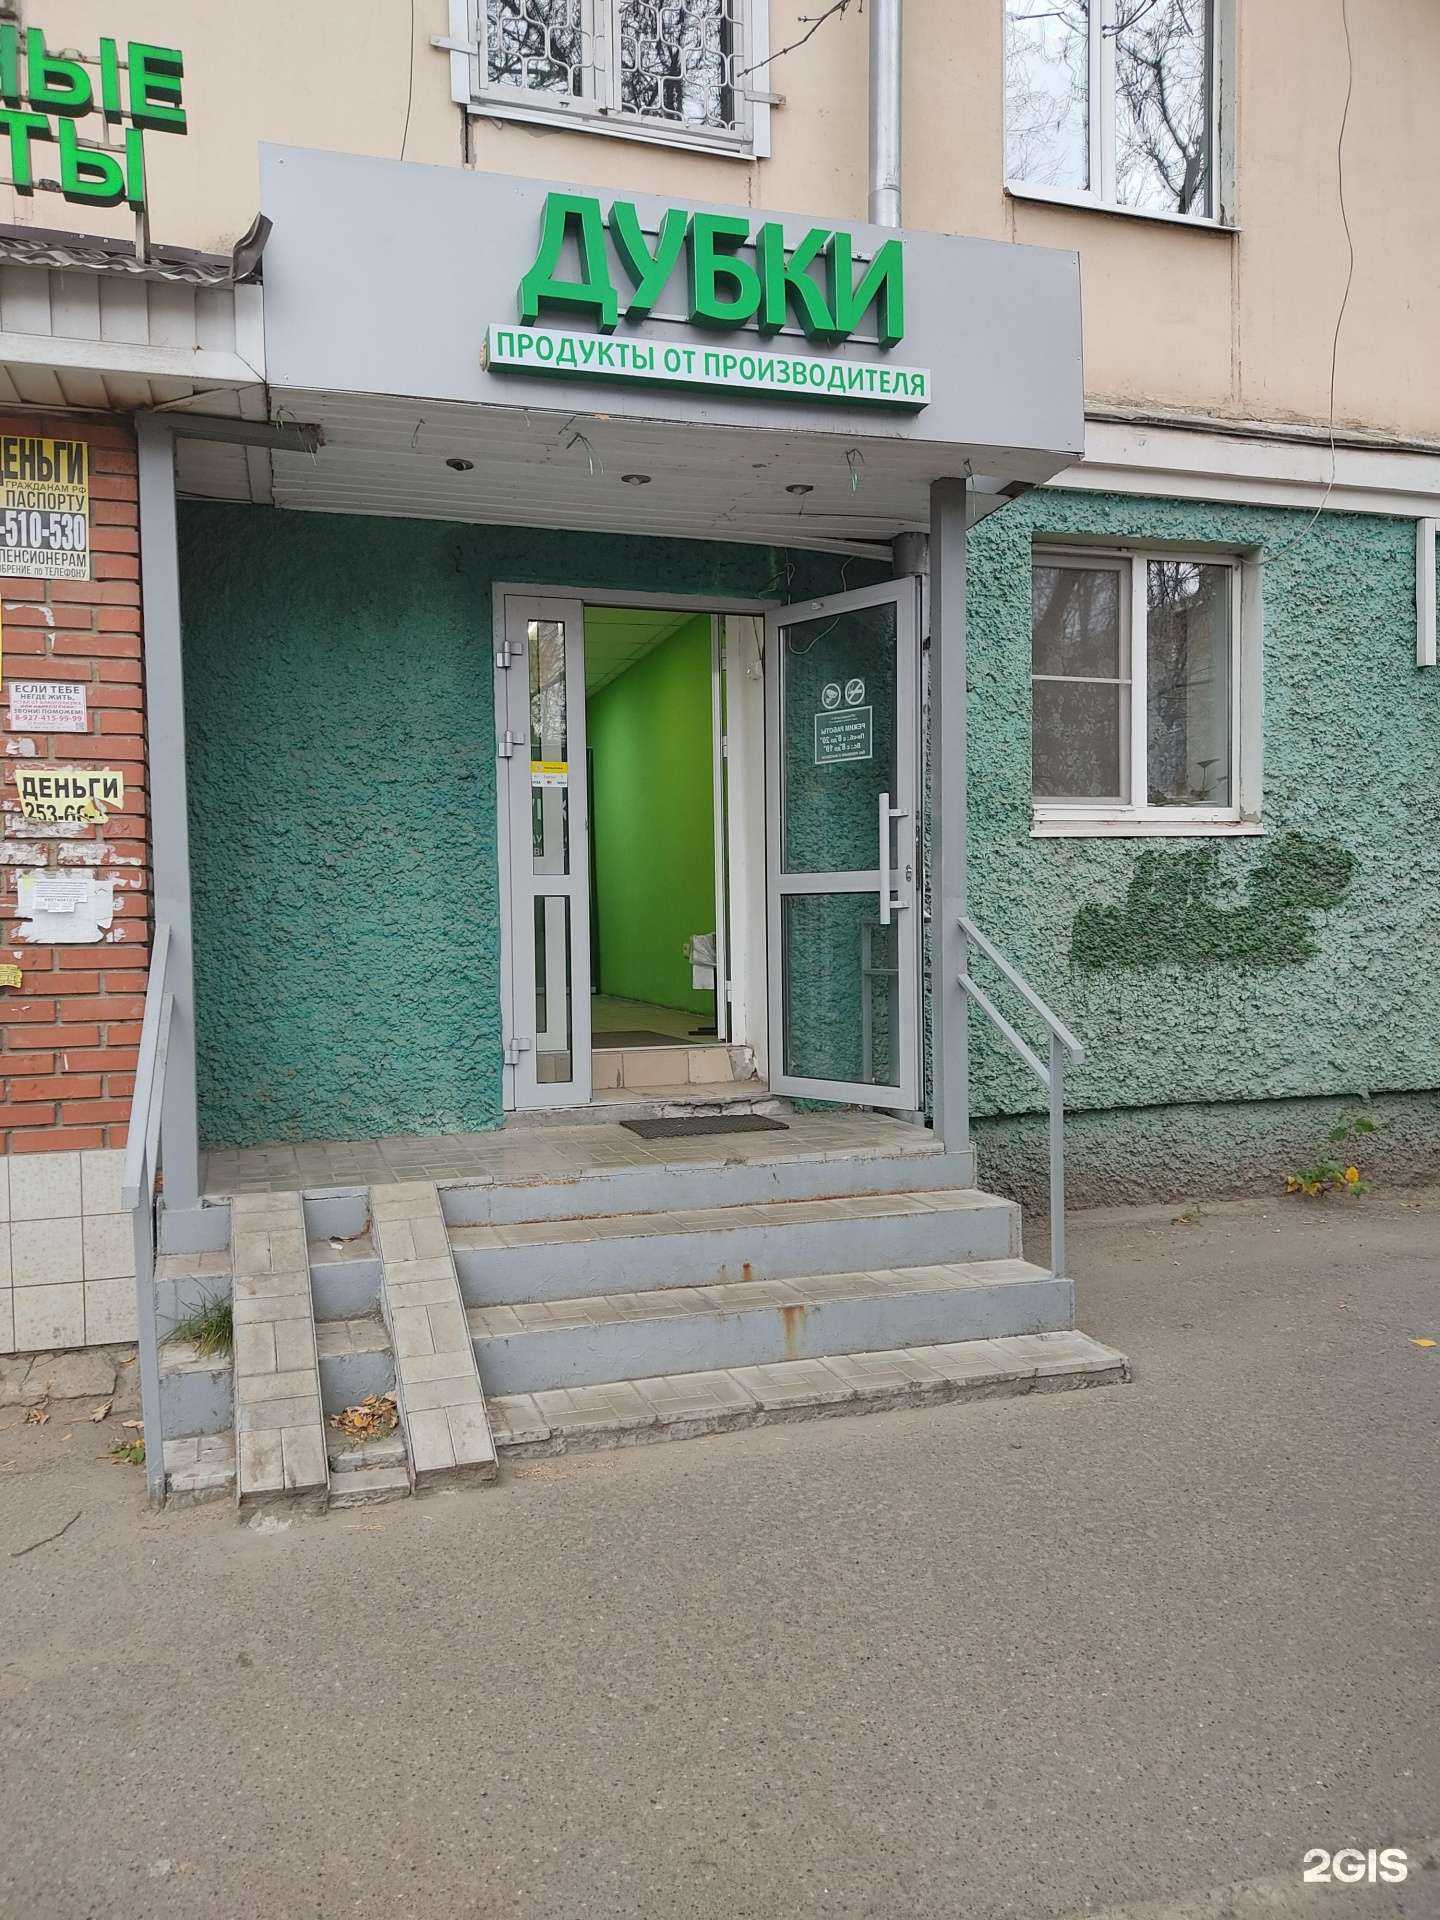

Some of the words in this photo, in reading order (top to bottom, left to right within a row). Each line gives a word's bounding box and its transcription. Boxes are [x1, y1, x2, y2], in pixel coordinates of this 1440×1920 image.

[0, 109, 144, 212] ТЫ
[517, 192, 905, 349] ДУБКИ
[497, 331, 655, 370] ПРОДУКТЫ
[663, 347, 696, 375] ОТ
[703, 352, 926, 397] ПРОИЗВОДИТЕЛЯ
[0, 436, 84, 486] ЕНЬГИ
[5, 480, 69, 493] ГРАЖДАНАМ
[72, 486, 87, 494] РФ
[6, 489, 85, 512] ПАСПОРТУ
[0, 548, 87, 568] ПЕНСИОНЕРАМ
[45, 567, 87, 578] ТЕЛЕФОНУ
[15, 684, 47, 693] ЕСЛИ
[50, 685, 80, 694] ТЕБЕ
[22, 776, 118, 801] ДЕНЬГИ
